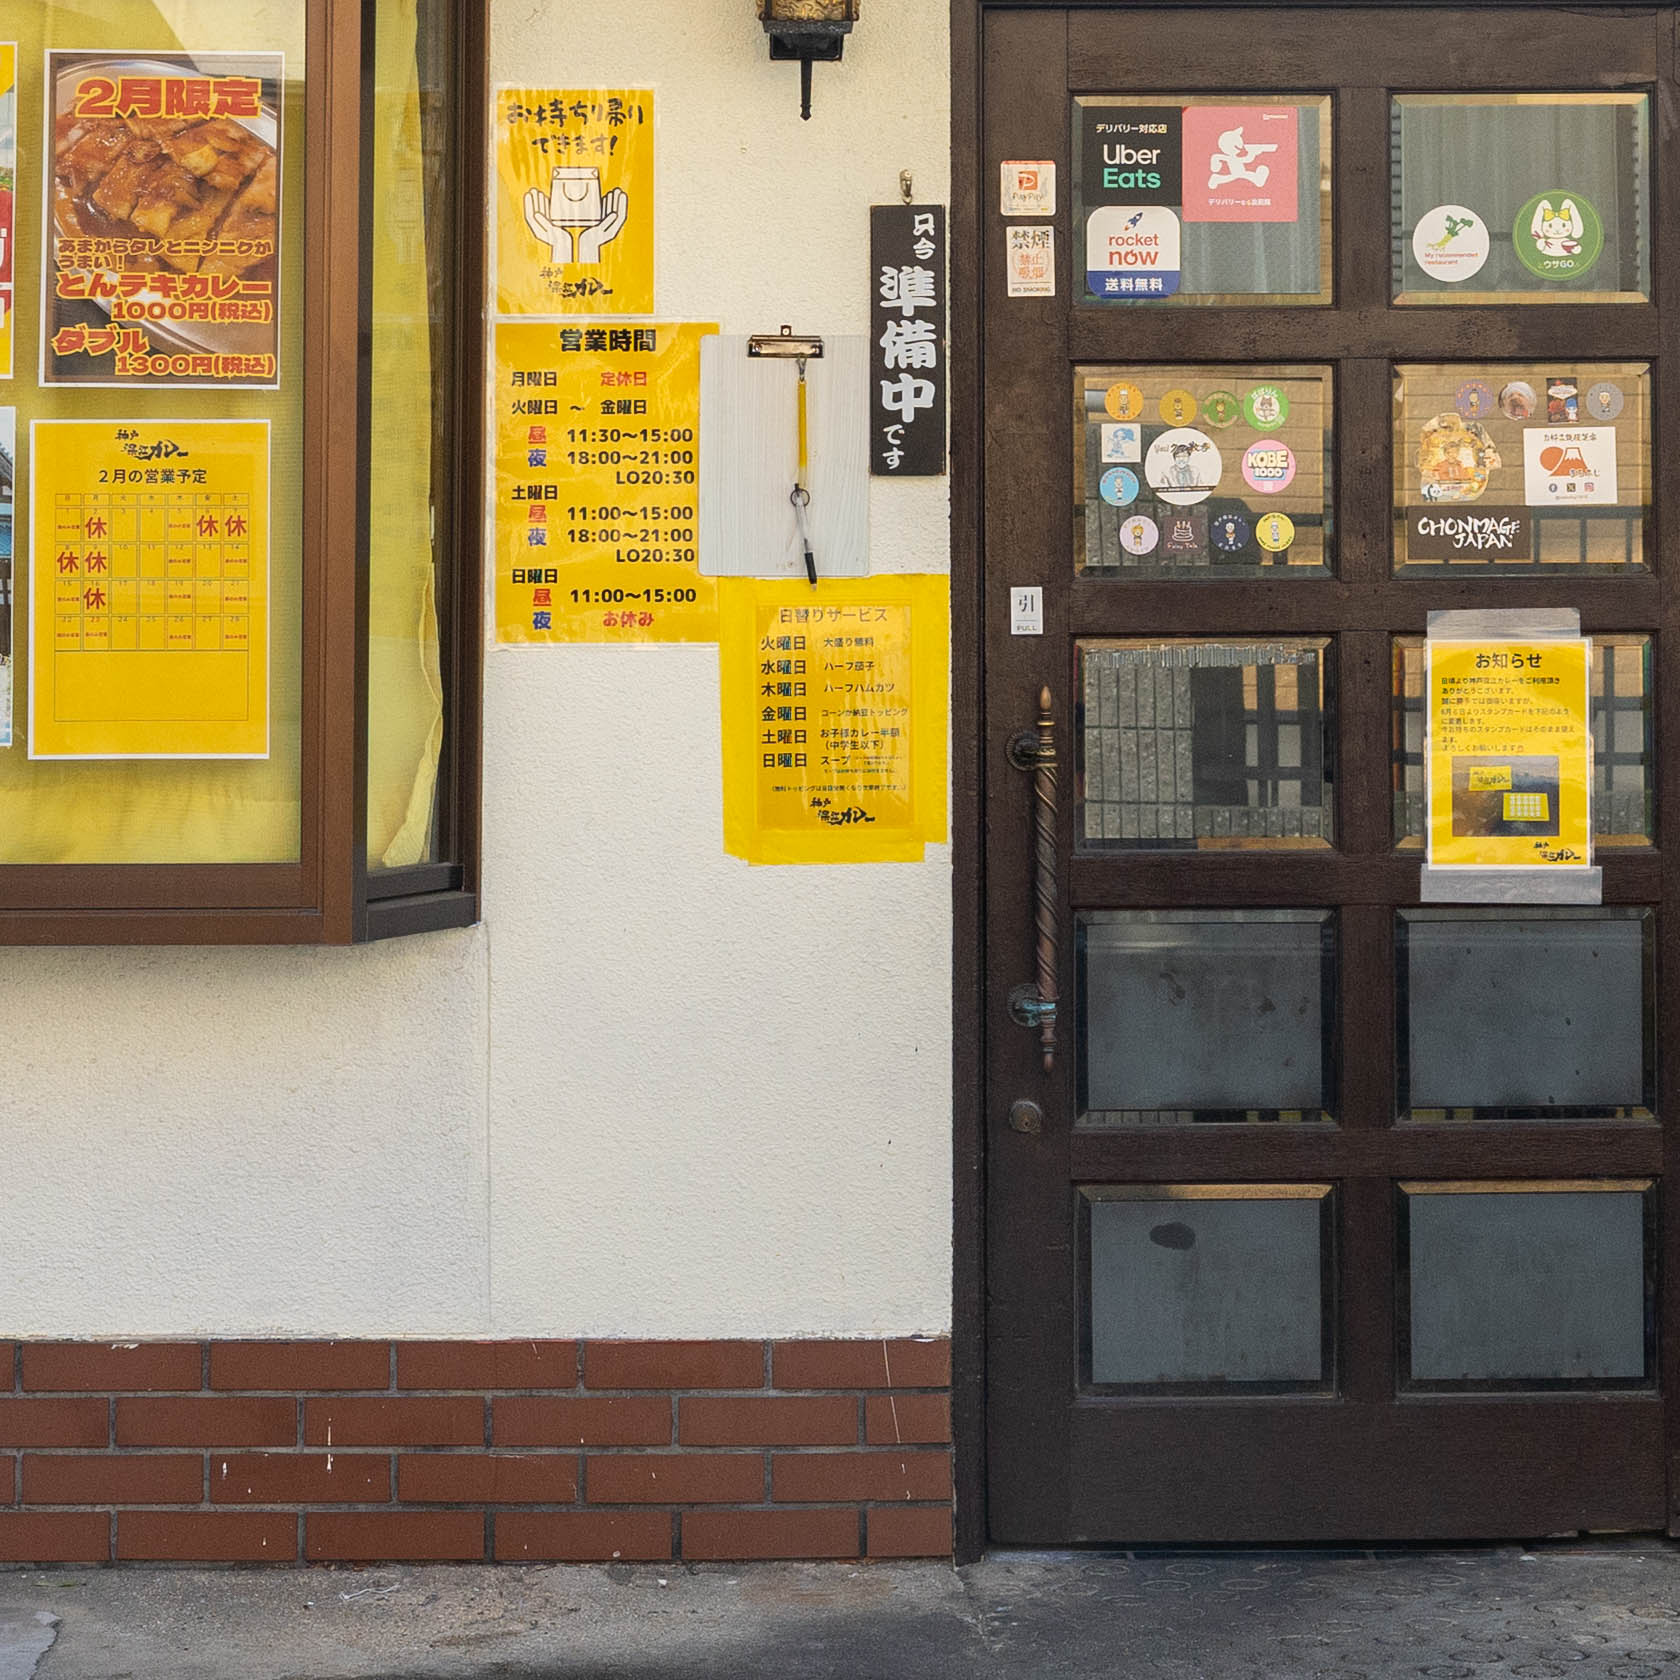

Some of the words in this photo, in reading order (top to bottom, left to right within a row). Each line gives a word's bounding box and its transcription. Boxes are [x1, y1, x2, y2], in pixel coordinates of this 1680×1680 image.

[76, 77, 262, 119] 2月限定
[507, 98, 643, 127] お持ち帰り
[1096, 124, 1167, 134] デリバリー対応店
[1103, 144, 1161, 165] Uber
[1103, 168, 1161, 188] Eats
[1012, 230, 1050, 249] 禁煙
[1108, 234, 1159, 247] rocket
[1108, 249, 1158, 265] now
[1544, 260, 1574, 269] ウサGO
[57, 273, 272, 300] とんテキカレー
[1105, 277, 1163, 292] 送料無料
[52, 324, 149, 355] ダブル
[560, 329, 657, 352] 営業時間
[880, 265, 937, 424] 準備中
[511, 372, 558, 386] 月曜日
[601, 372, 647, 386] 定休日
[511, 400, 558, 414] 火曜日
[600, 400, 647, 414] 金曜日
[528, 426, 546, 444] 昼
[528, 449, 546, 467] 夜
[1247, 450, 1288, 468] KOBE
[616, 471, 695, 485] LO20:30
[1254, 468, 1283, 478] 1000
[511, 485, 558, 500] 土曜日
[528, 505, 546, 523] 昼
[86, 517, 107, 538] 休
[197, 515, 218, 537] 休
[225, 515, 247, 537] 休
[1418, 516, 1520, 536] CHONMAGE
[528, 528, 546, 546] 夜
[1453, 534, 1513, 550] JAPAN
[57, 551, 79, 573] 休
[85, 551, 107, 573] 休
[616, 549, 695, 562] LO20:30
[511, 569, 558, 584] 日曜日
[84, 588, 105, 609] 休
[533, 588, 552, 606] 昼
[1018, 593, 1035, 612] 引
[533, 611, 552, 630] 夜
[603, 611, 655, 627] お休み
[780, 608, 888, 623] 日替りサービス
[761, 636, 807, 651] 火曜日
[761, 660, 807, 675] 水曜日
[1476, 653, 1542, 669] お知らせ
[761, 682, 807, 697] 木曜日
[824, 682, 895, 693] ハーフハムカツ
[762, 706, 807, 721] 金曜日
[762, 730, 807, 744] 土曜日
[763, 753, 807, 768] 日曜日
[820, 754, 851, 766] スープ
